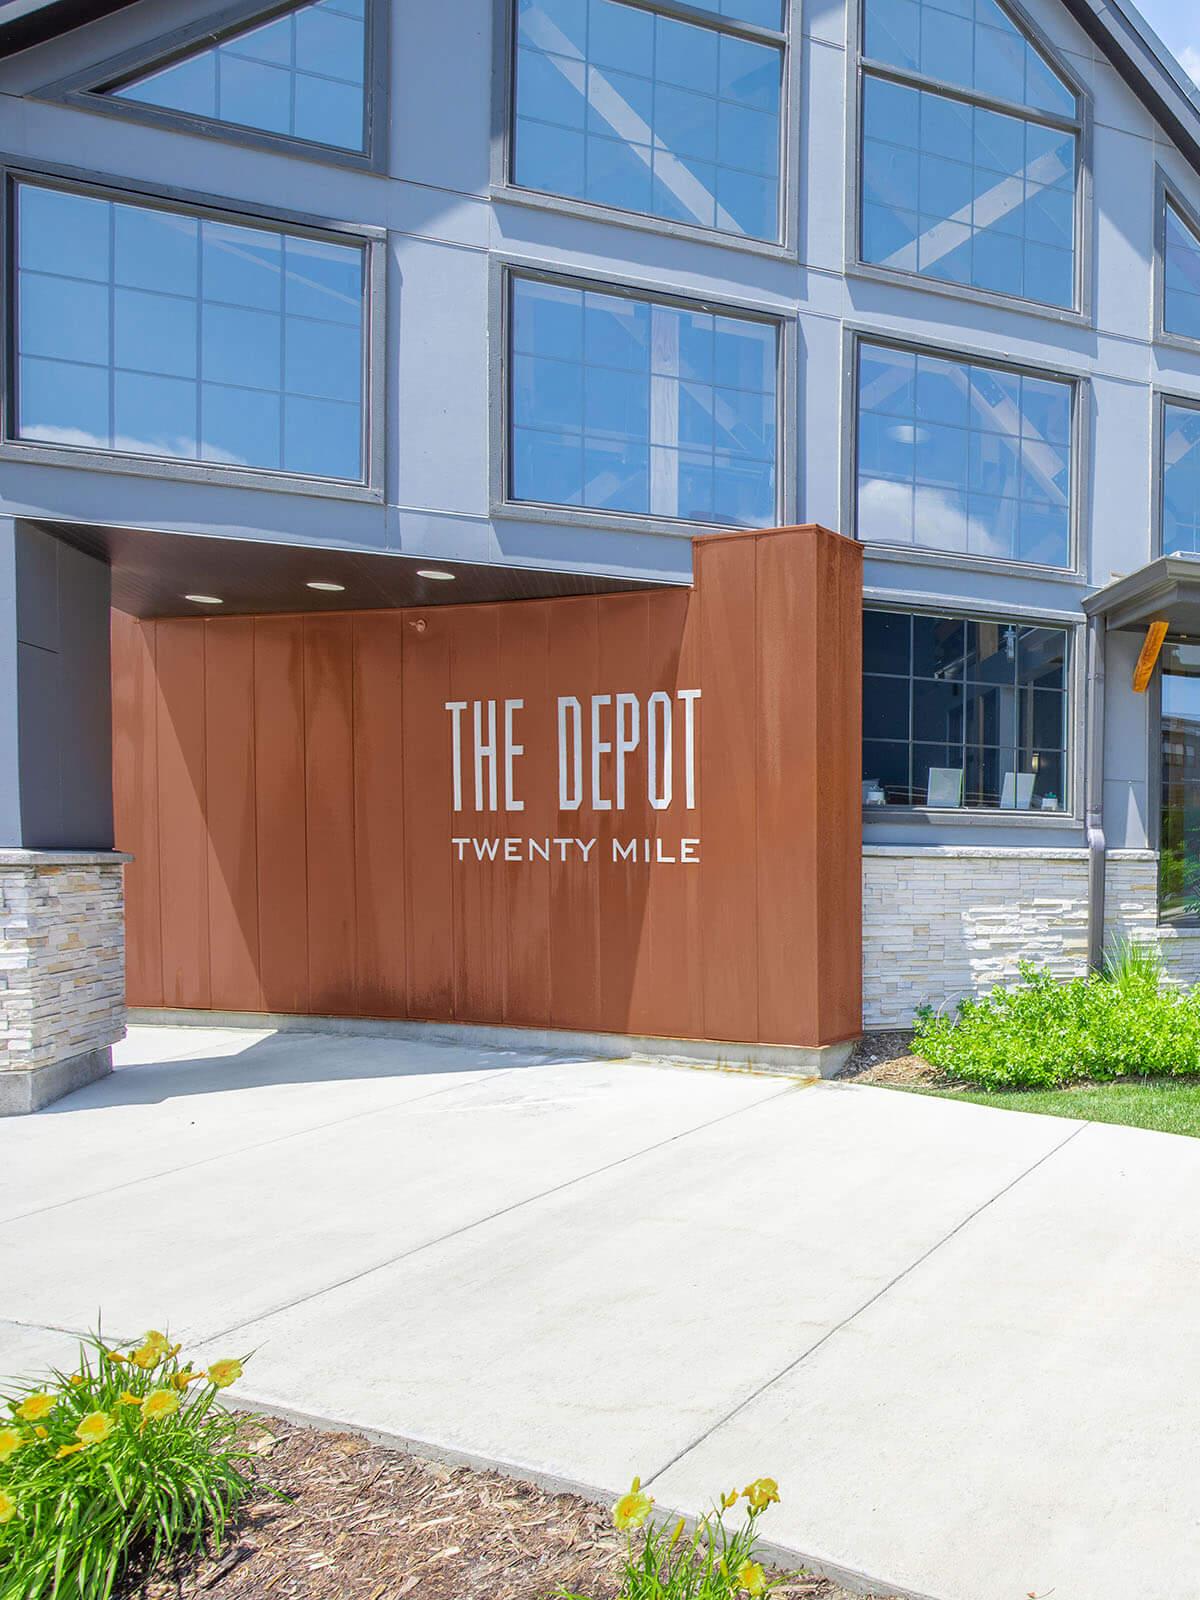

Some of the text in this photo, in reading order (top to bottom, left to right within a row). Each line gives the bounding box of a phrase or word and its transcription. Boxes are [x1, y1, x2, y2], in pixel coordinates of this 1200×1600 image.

[445, 689, 701, 811] THE DEPOT
[451, 838, 701, 863] TWENTY MILE
